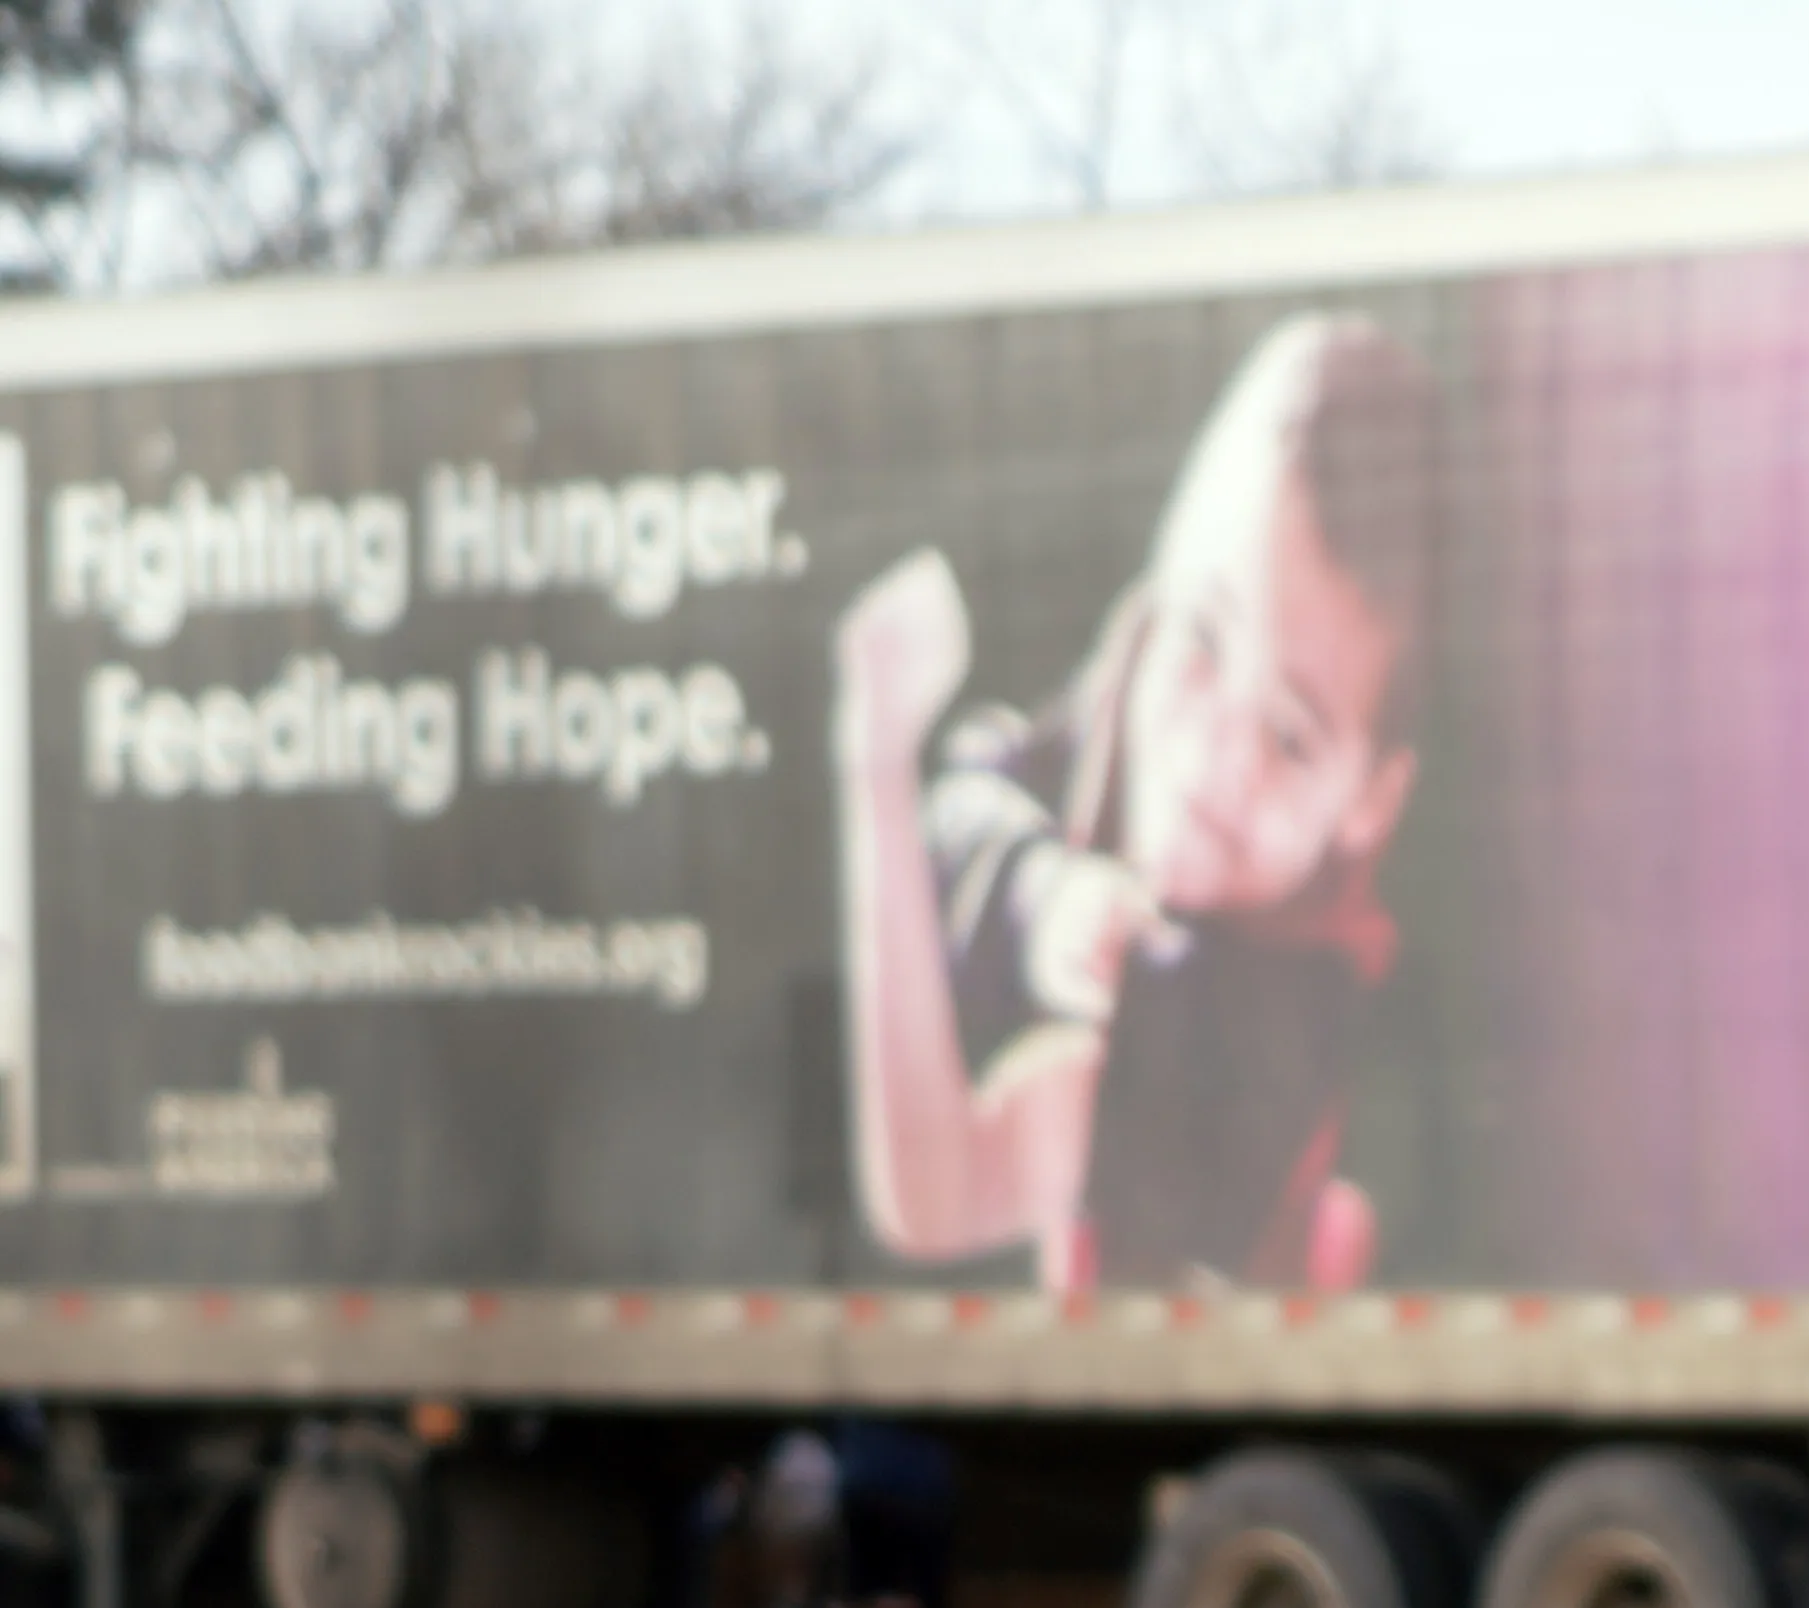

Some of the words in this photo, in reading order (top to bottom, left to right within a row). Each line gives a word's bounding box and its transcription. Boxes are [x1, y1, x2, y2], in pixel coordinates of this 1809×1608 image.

[54, 472, 406, 643] Fighting
[427, 463, 806, 616] Hunger.
[88, 653, 456, 814] Feeding
[481, 648, 769, 804] Hope.
